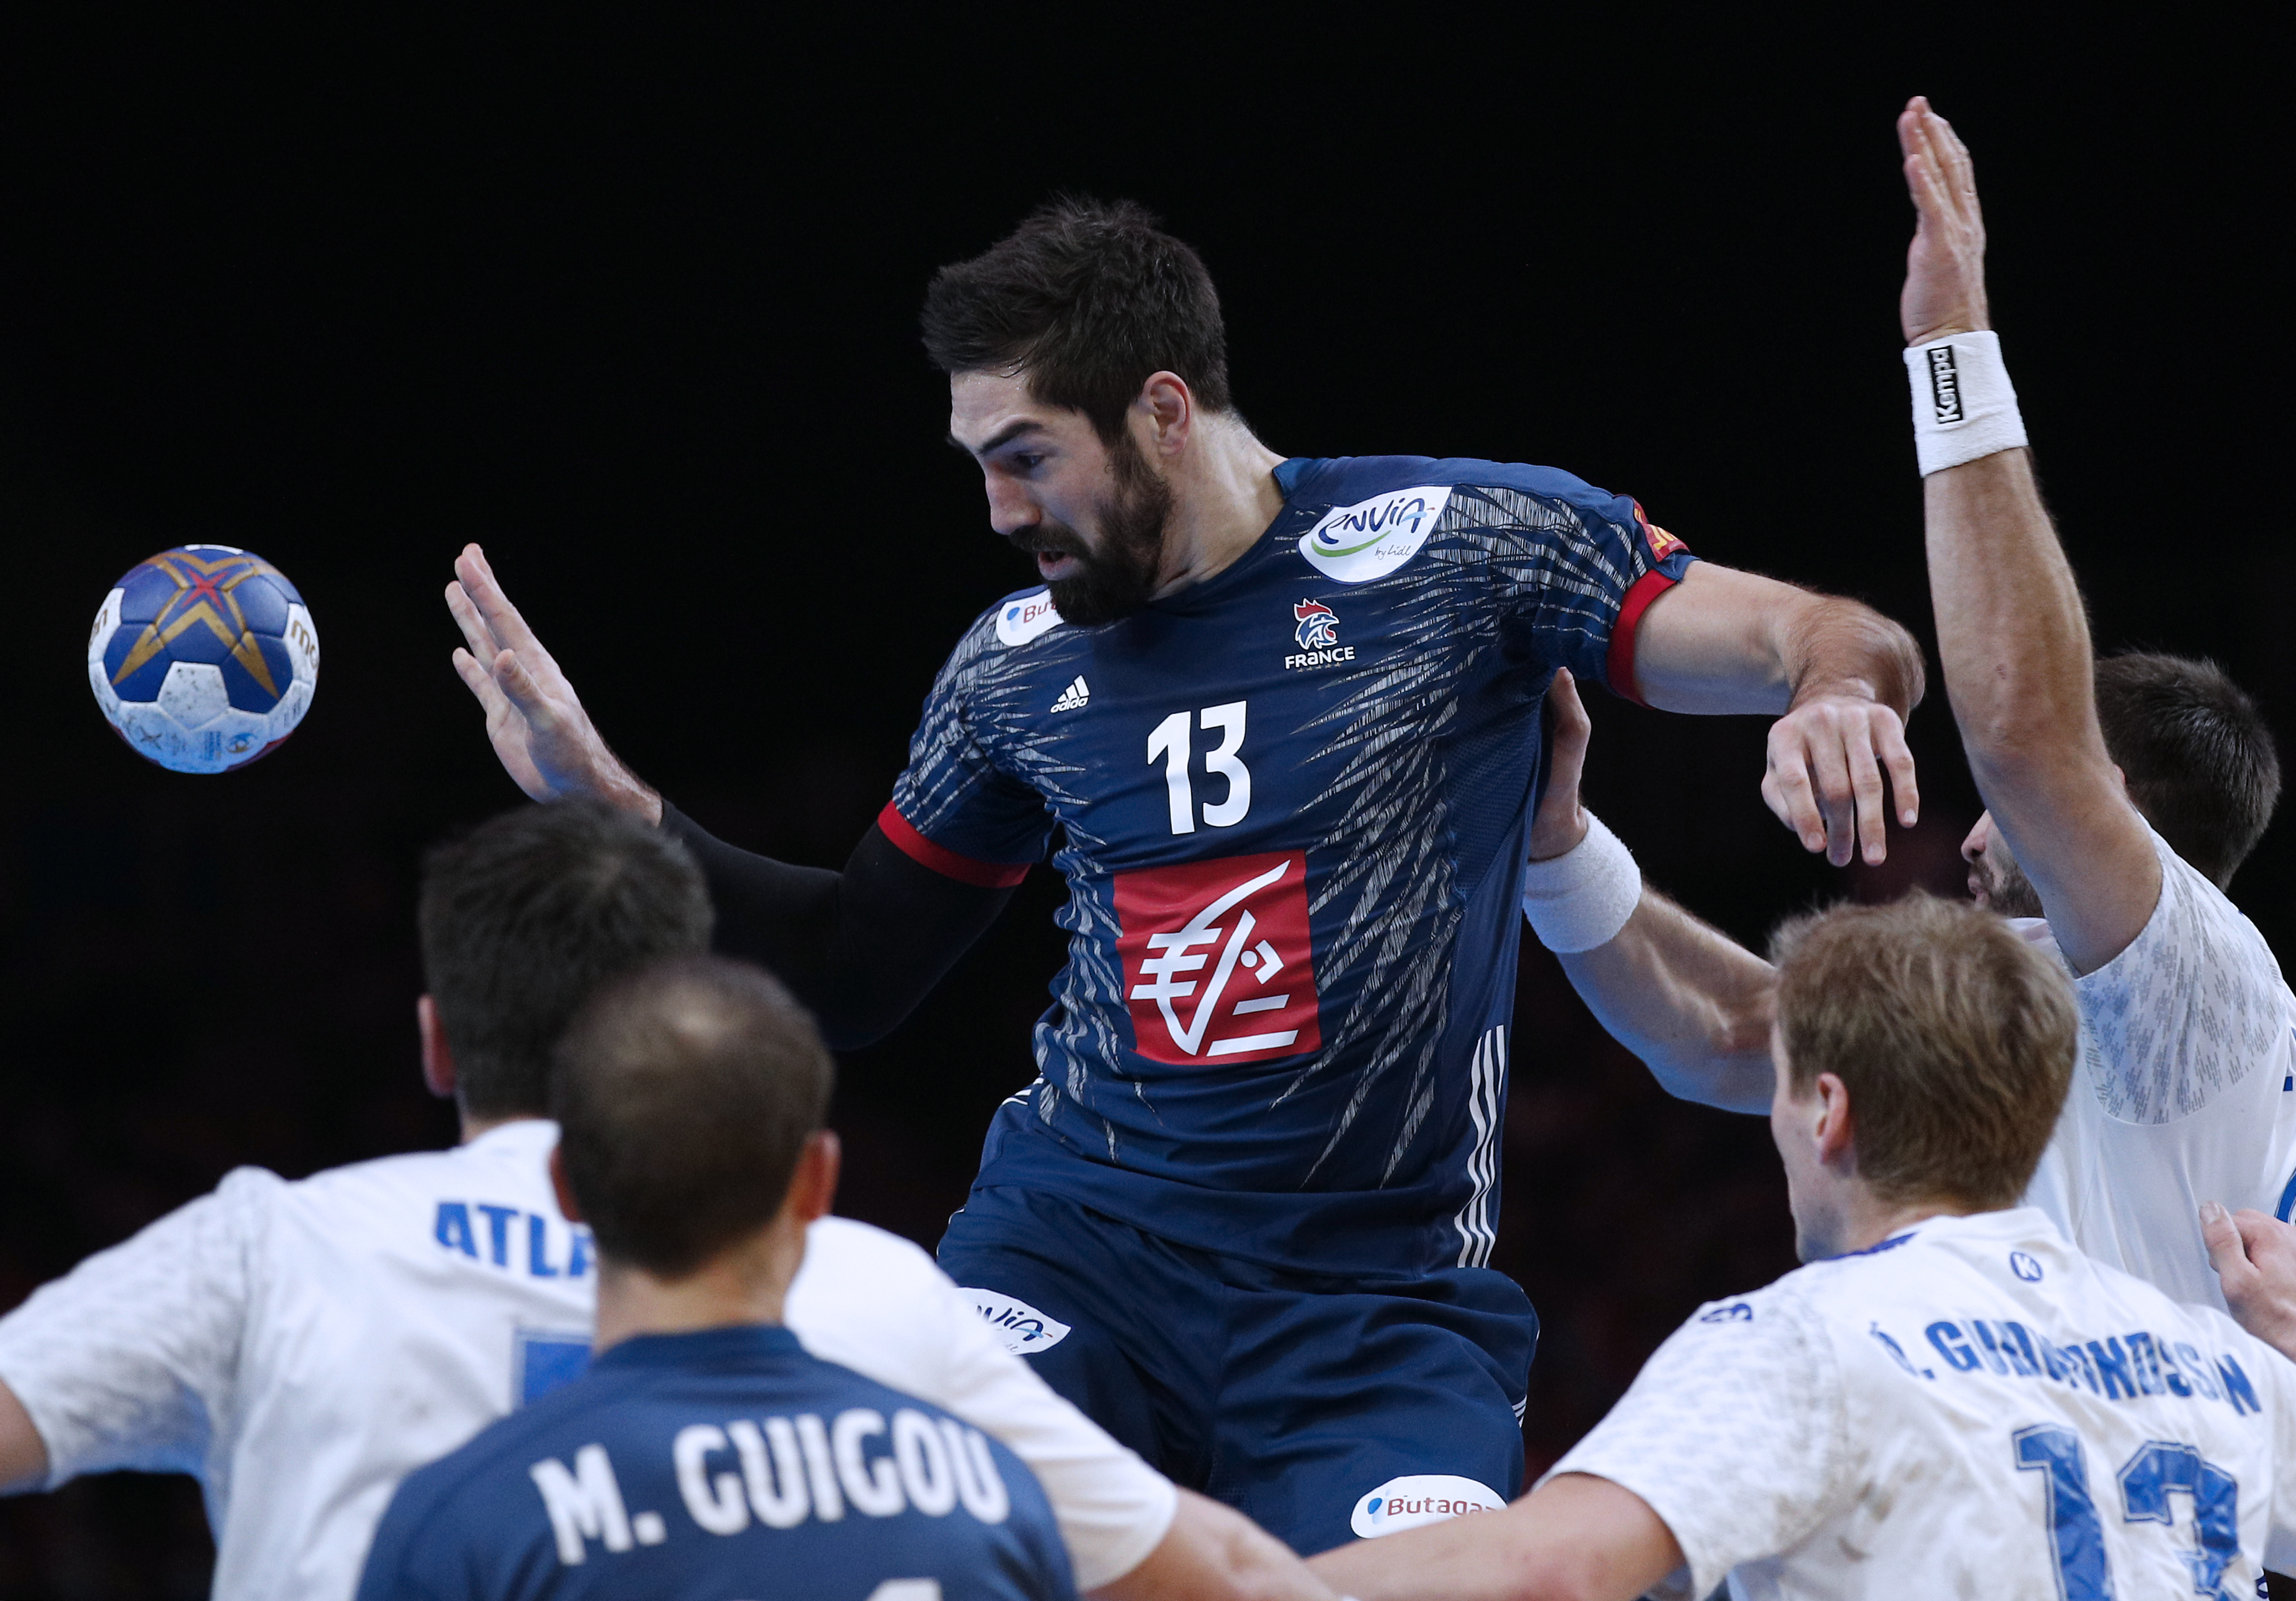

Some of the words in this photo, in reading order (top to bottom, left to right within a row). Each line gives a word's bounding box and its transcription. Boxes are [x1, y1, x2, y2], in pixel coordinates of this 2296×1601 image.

[1929, 348, 1961, 423] Kempa
[1374, 546, 1386, 560] by
[1387, 544, 1411, 556] Lidl
[1050, 696, 1089, 714] adida
[1146, 700, 1252, 836] 13
[529, 1443, 666, 1566] M.
[673, 1408, 1009, 1536] GUIGOU
